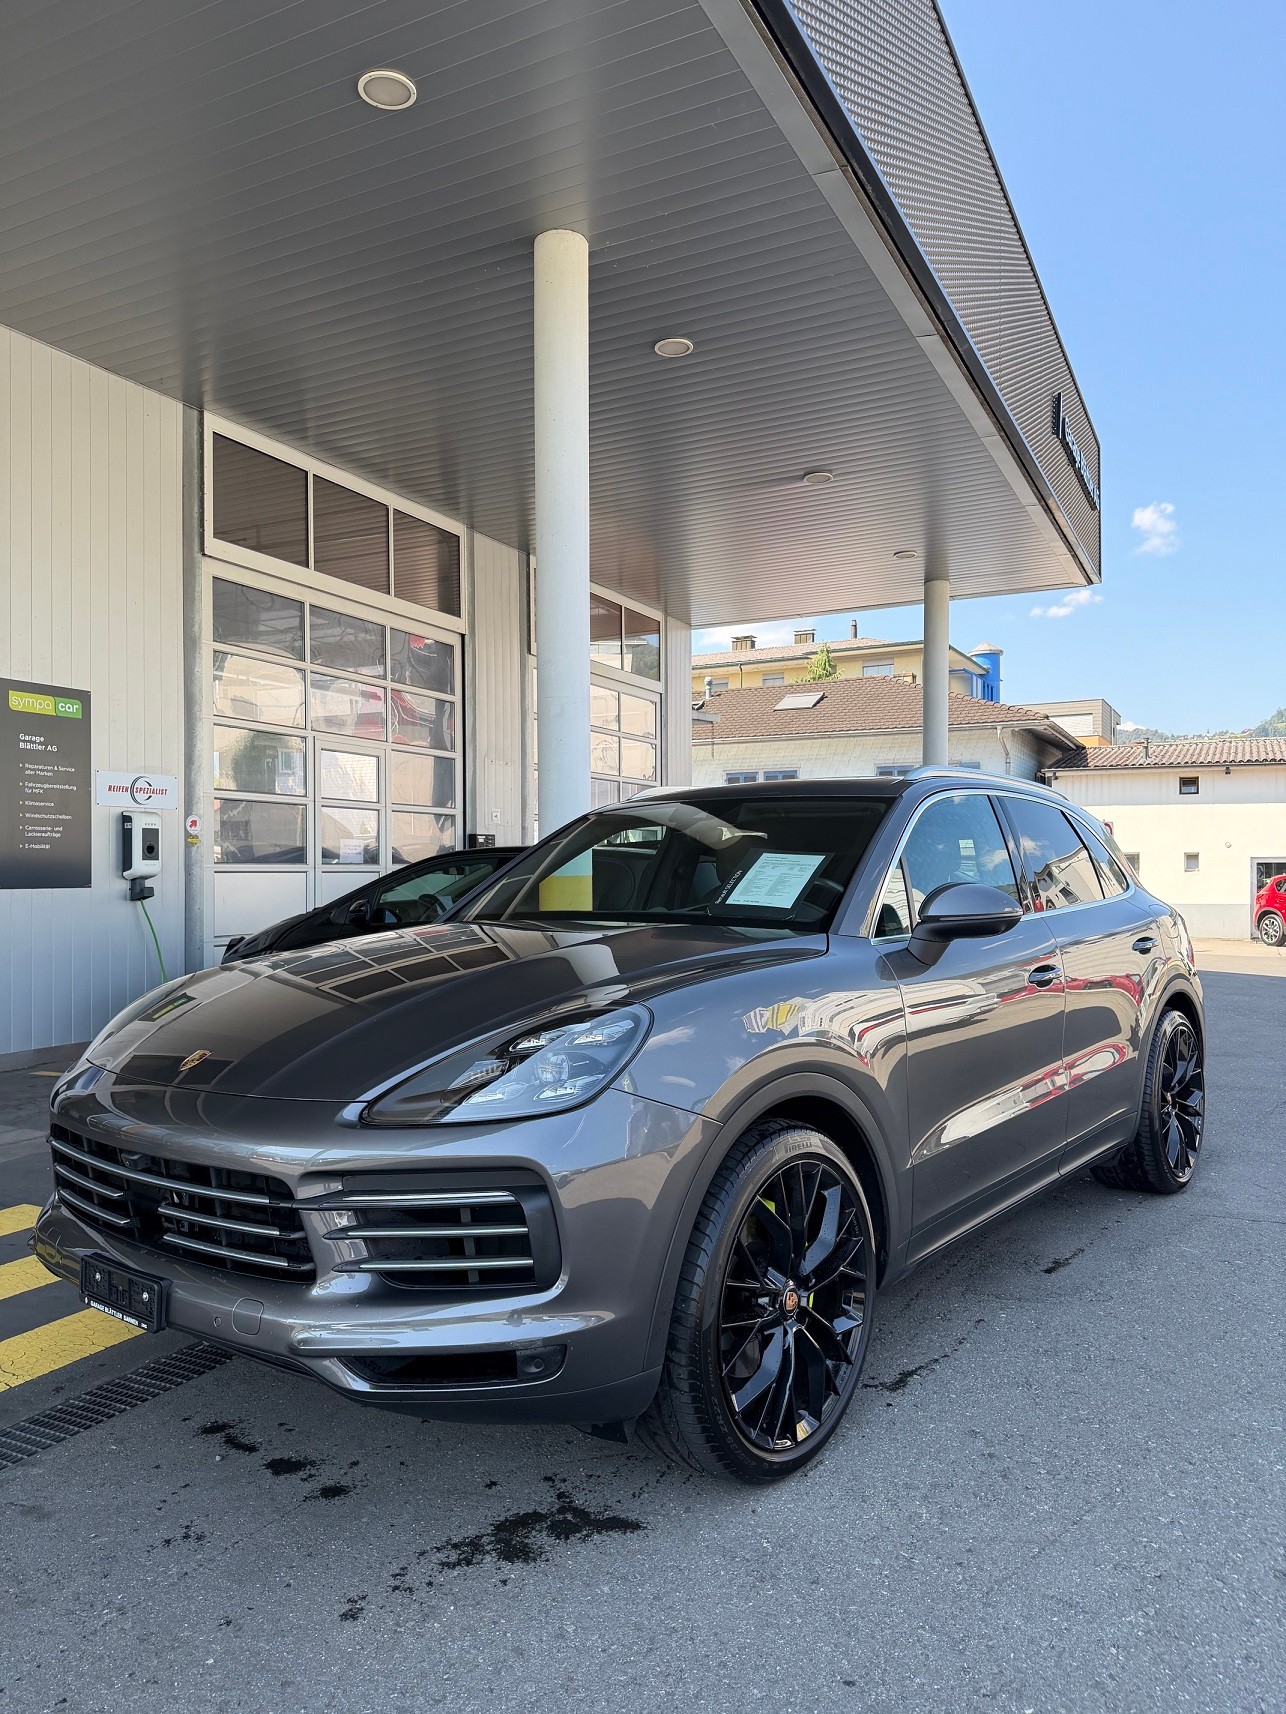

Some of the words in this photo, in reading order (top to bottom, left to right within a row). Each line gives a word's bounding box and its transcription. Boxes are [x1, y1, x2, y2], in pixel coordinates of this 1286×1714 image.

[12, 696, 52, 710] sympa
[58, 702, 79, 713] car
[19, 733, 45, 743] Garage
[19, 742, 46, 751] Blättler
[107, 784, 130, 793] REIFEN
[134, 786, 168, 796] SPEZIALIST
[24, 812, 73, 820] Windschutzscheiben
[783, 1138, 813, 1154] PIRELLI
